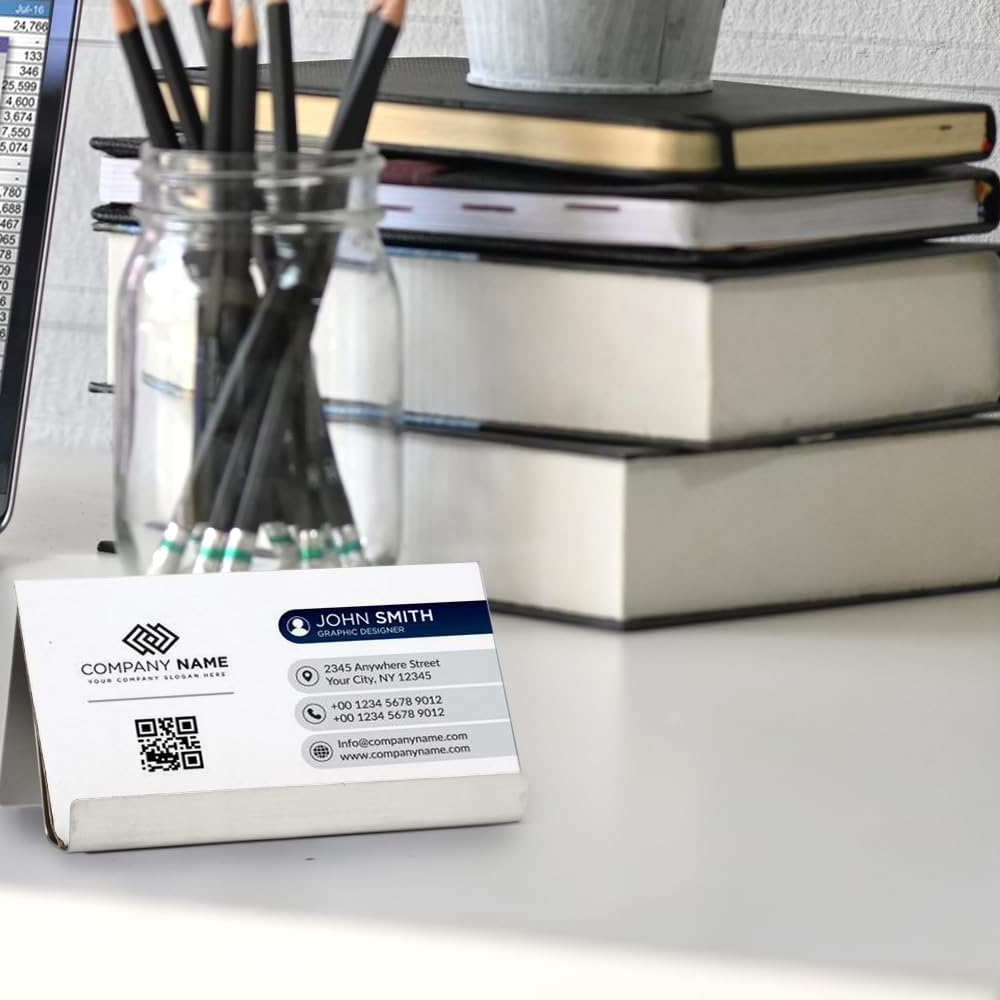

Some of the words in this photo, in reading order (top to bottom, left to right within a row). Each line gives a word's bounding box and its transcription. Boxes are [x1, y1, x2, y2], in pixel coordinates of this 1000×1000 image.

[16, 3, 44, 14] Jul-16
[13, 21, 48, 32] 24,766
[24, 51, 42, 61] 133
[19, 66, 38, 76] 346
[2, 81, 37, 92] 25,599
[6, 97, 35, 108] 4,600
[4, 111, 32, 123] 3,674
[2, 127, 30, 138] 7,550
[316, 612, 370, 628] JOHN
[375, 610, 434, 624] SMITH
[318, 629, 359, 637] GRAPHIC
[361, 627, 405, 635] DESIGNER
[81, 660, 170, 676] COMPANY
[177, 657, 229, 670] NAME
[324, 664, 352, 673] 2345
[354, 661, 406, 671] Anywhere
[410, 659, 440, 668] Street
[326, 676, 350, 686] Your
[353, 675, 377, 685] City,
[379, 674, 394, 682] NY
[399, 671, 432, 681] 12345
[332, 701, 352, 710] +00
[356, 699, 382, 709] 1234
[385, 697, 412, 707] 5678
[415, 695, 442, 706] 9012
[334, 714, 354, 723] +00
[358, 712, 384, 722] 1234
[387, 710, 415, 720] 5678
[417, 708, 444, 718] 9012
[338, 731, 468, 748] Info@companyname.com
[340, 744, 470, 761] www.companyname.com
